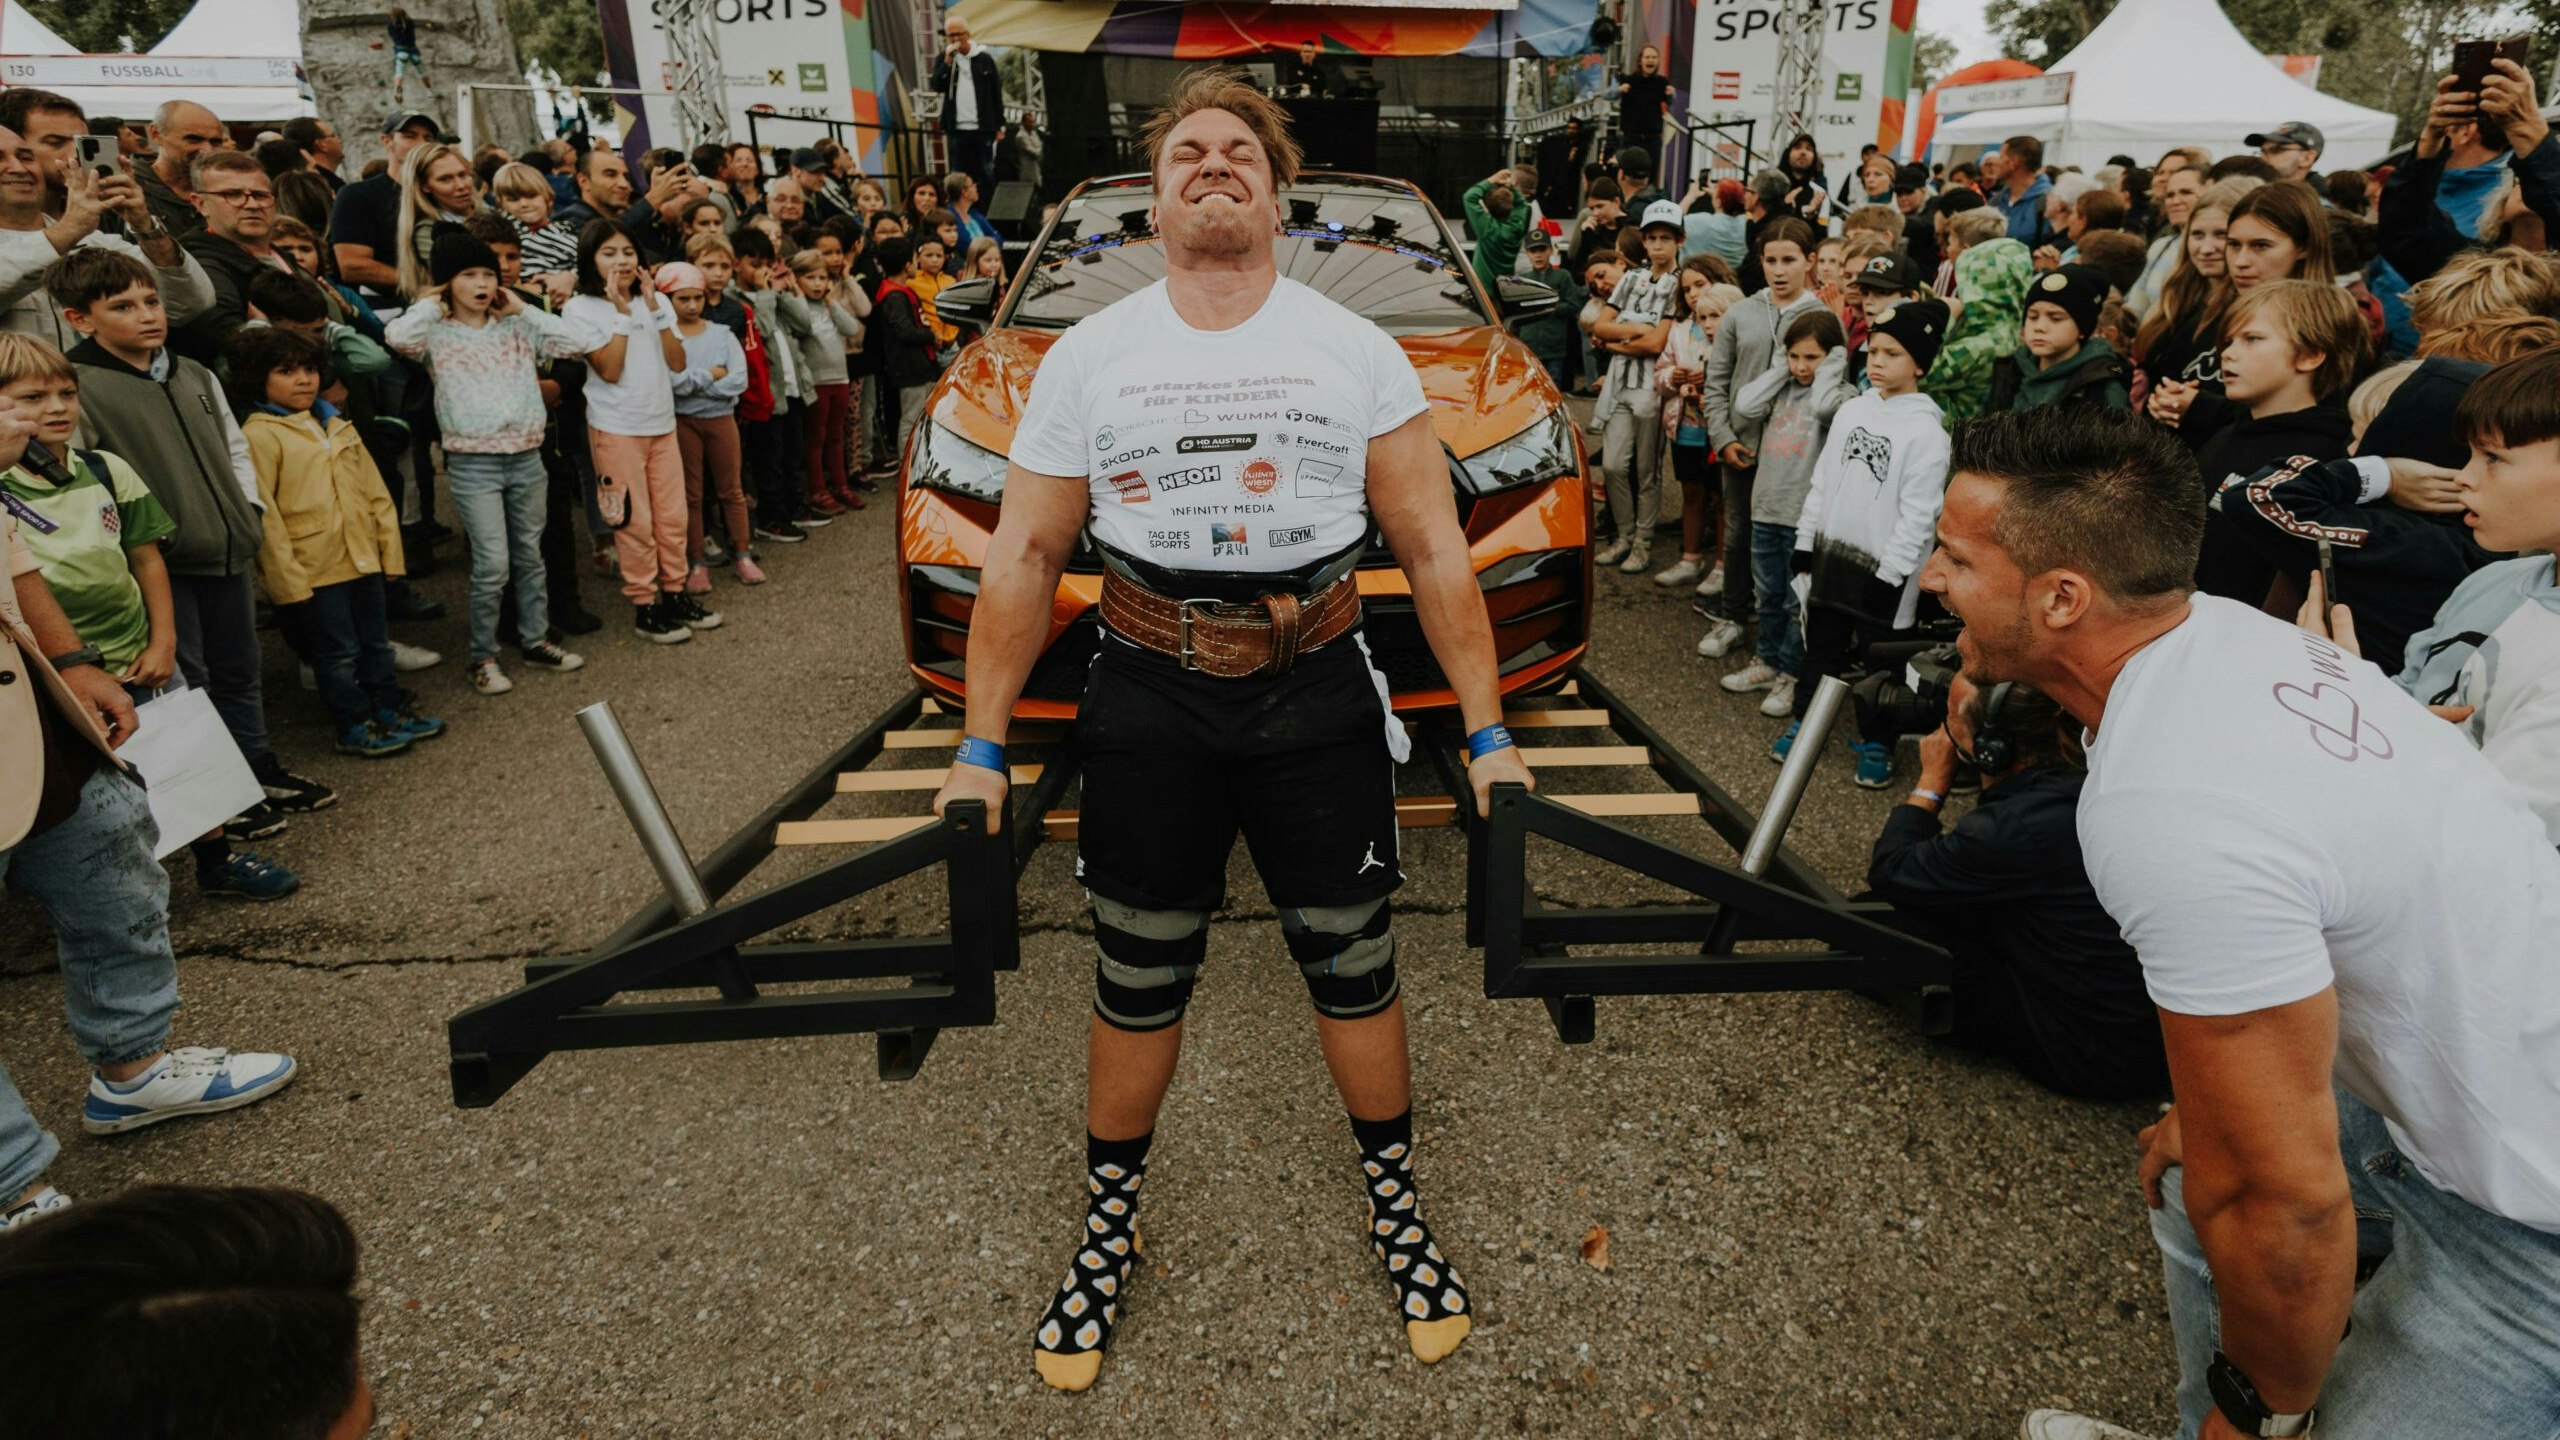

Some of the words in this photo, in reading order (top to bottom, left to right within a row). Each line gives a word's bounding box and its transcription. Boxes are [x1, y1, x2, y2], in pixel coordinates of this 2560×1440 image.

[9, 65, 35, 77] 130
[101, 65, 184, 78] FUSSBALL
[1119, 385, 1148, 398] Ein
[1152, 381, 1232, 391] starkes
[1238, 376, 1316, 387] Zeichen
[1143, 395, 1179, 408] für
[1184, 389, 1288, 405] KINDER!
[1217, 411, 1278, 421] WUMM
[1212, 437, 1252, 445] AUSTRIA
[1296, 436, 1349, 455] EverCraft
[1159, 465, 1221, 491] NEOH
[1172, 505, 1228, 516] INFINITY
[1234, 503, 1275, 514] MEDIA
[20, 509, 47, 529] SPORTS
[1148, 530, 1165, 540] TAG
[1168, 530, 1190, 540] DES
[1150, 540, 1190, 550] SPORTS
